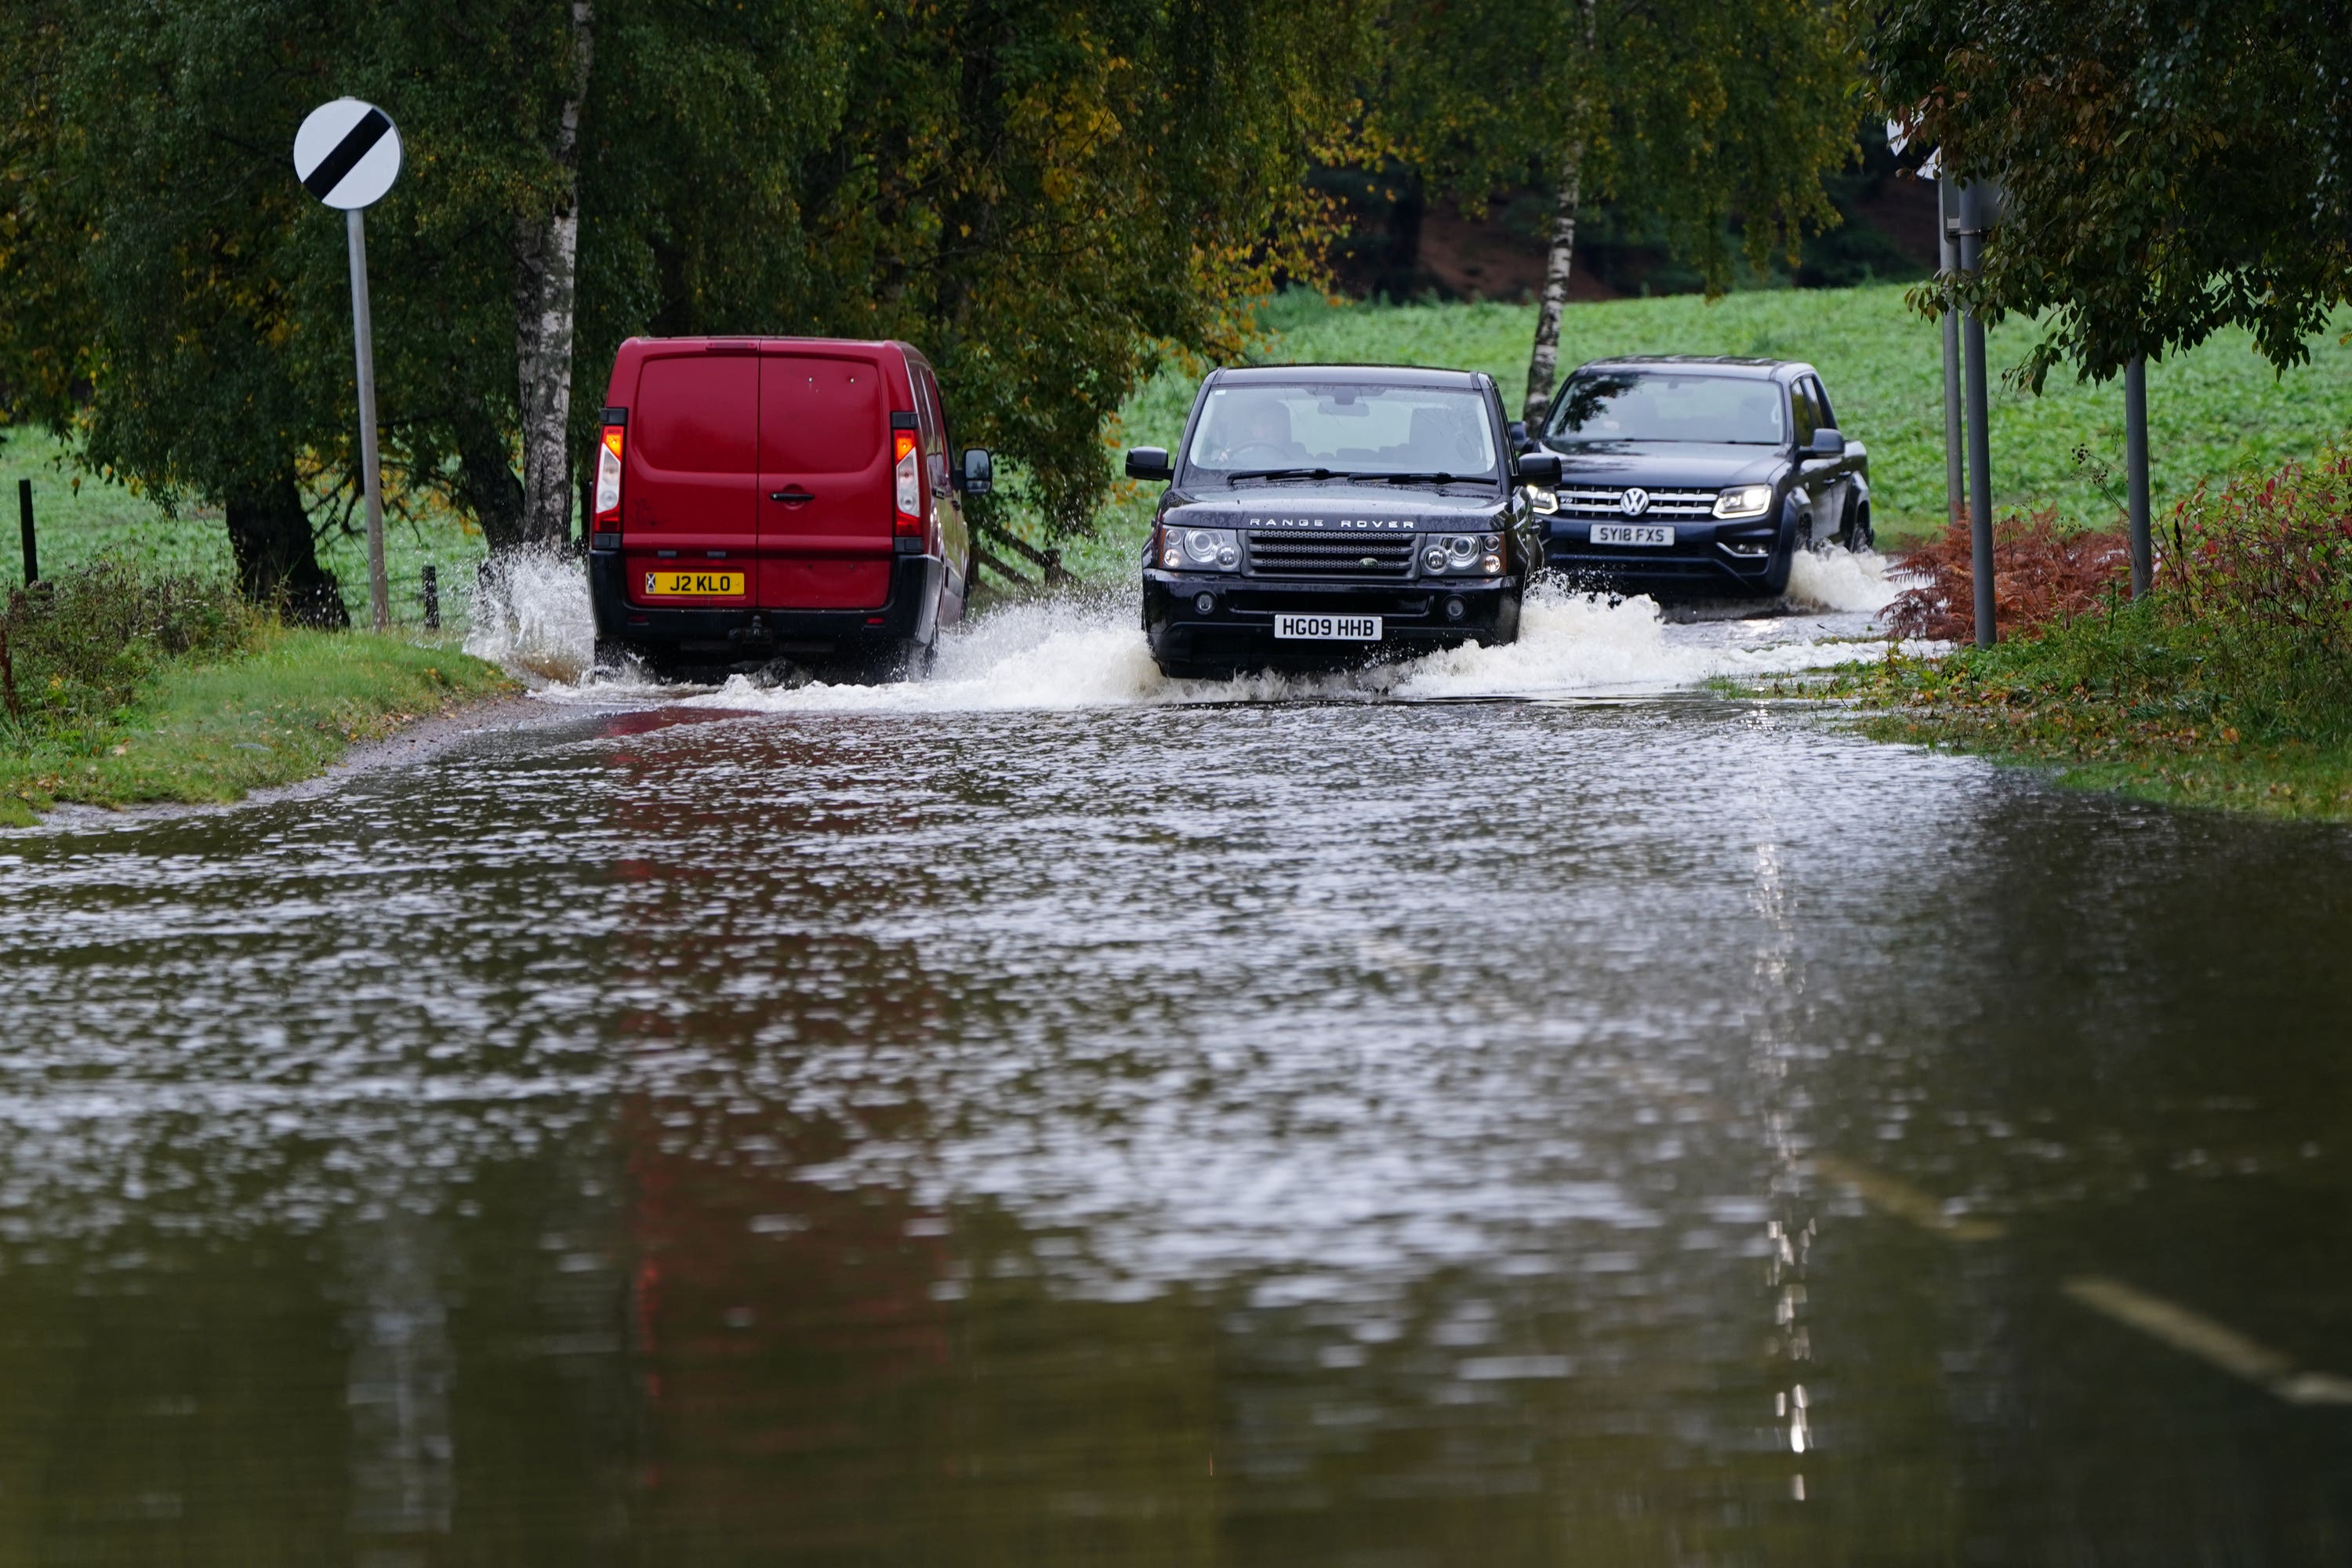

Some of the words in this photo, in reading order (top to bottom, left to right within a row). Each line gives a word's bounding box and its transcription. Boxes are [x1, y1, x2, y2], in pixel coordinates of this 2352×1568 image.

[1250, 518, 1324, 527] RANGE
[1599, 528, 1632, 541] SY18
[1635, 528, 1664, 543] FXS
[670, 575, 691, 591] J2
[696, 575, 731, 592] KLO
[1283, 618, 1332, 636] HG09
[1338, 619, 1374, 637] HHB
